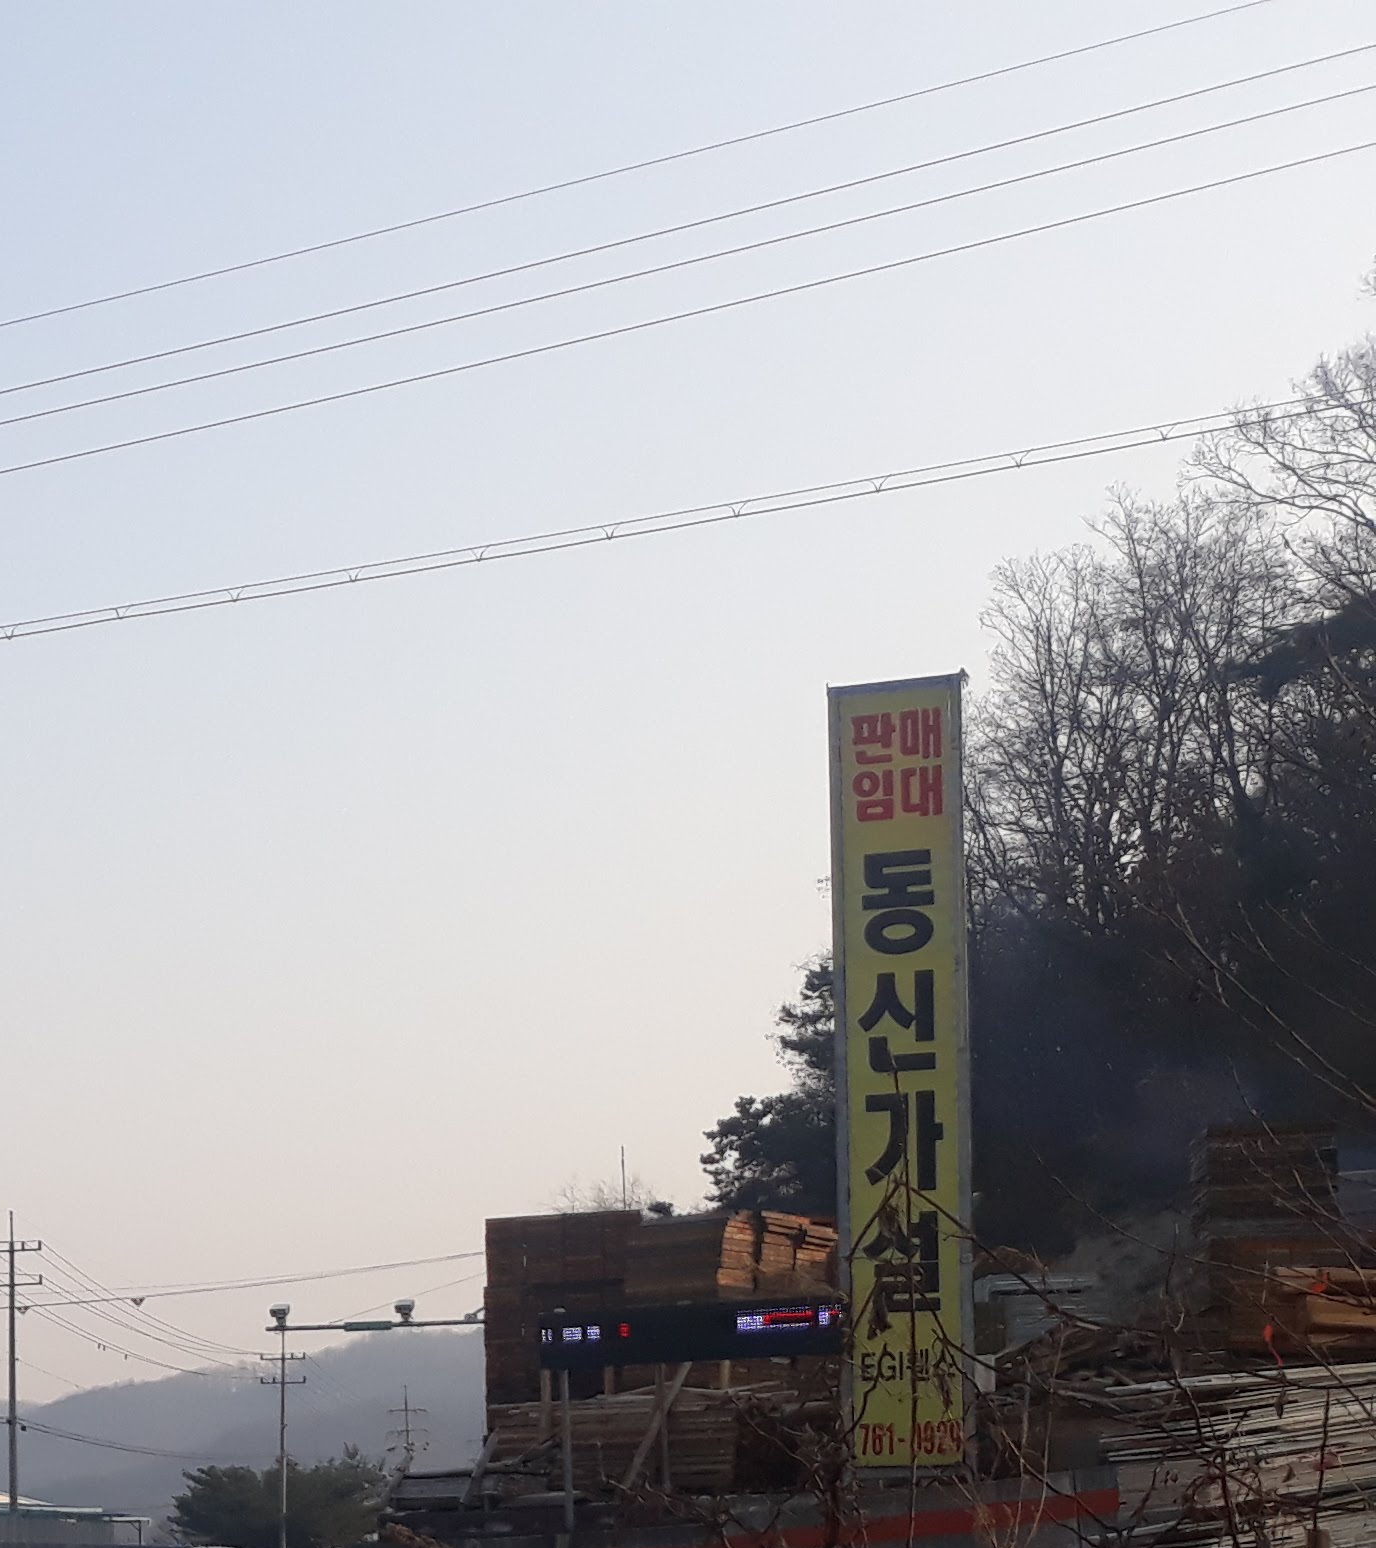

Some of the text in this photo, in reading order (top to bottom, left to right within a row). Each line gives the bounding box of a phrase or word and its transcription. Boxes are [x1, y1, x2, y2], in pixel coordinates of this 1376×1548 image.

[851, 707, 943, 765] 판매
[852, 764, 944, 822] 임대
[857, 848, 945, 1313] 동신가설
